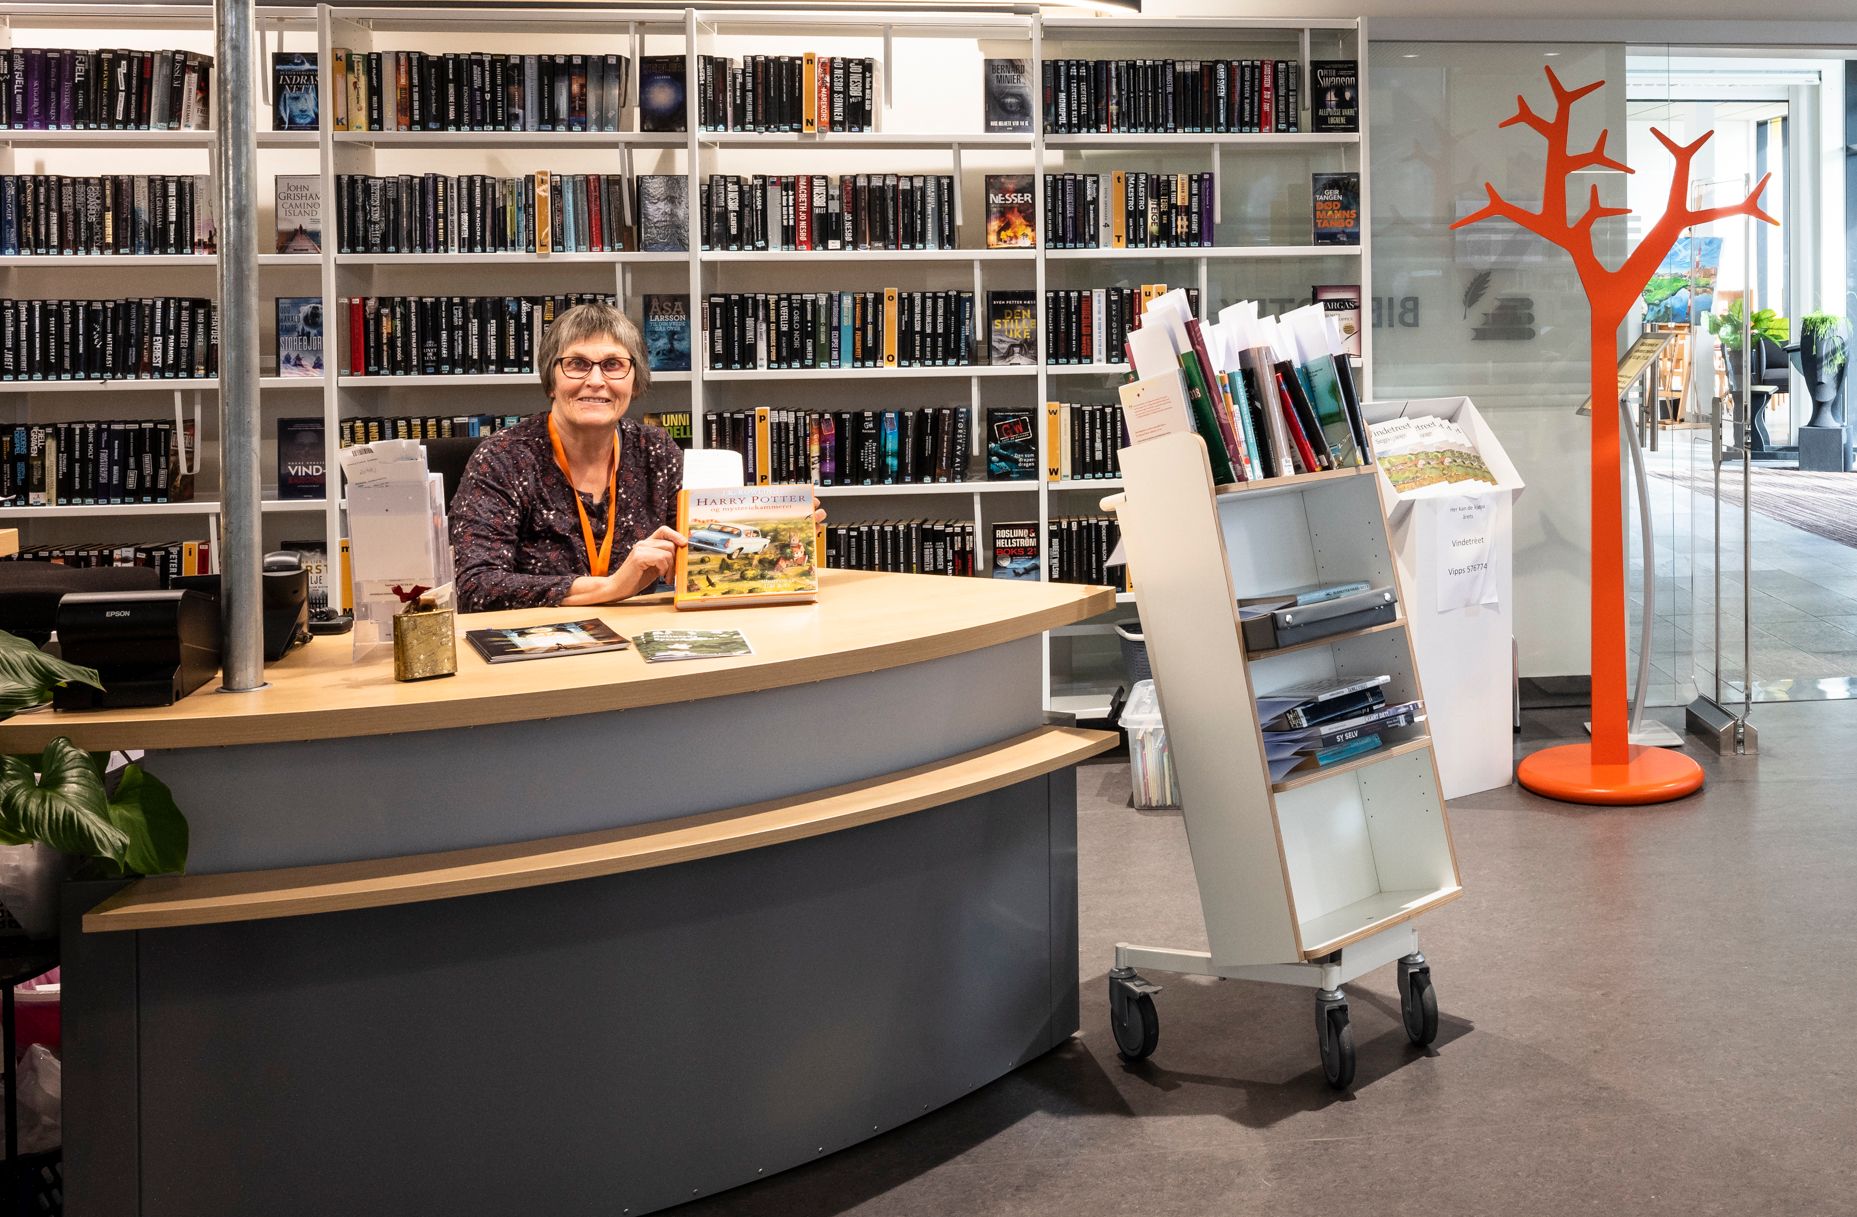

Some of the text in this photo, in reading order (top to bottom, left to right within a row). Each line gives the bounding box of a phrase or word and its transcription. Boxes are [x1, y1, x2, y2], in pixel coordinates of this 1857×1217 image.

[336, 53, 343, 61] k
[75, 56, 85, 83] FJELL
[991, 64, 1025, 74] BERNARD
[14, 71, 24, 95] FJELL
[833, 69, 844, 91] NESBØ
[849, 63, 863, 96] JO NESBØ
[996, 75, 1021, 84] MINIER
[1217, 80, 1225, 96] SVEEN
[820, 88, 828, 121] MAREKORS
[833, 93, 844, 121] SØNNEN
[1058, 92, 1066, 125] MONOPOL
[806, 118, 814, 126] N
[286, 182, 310, 192] JOHN
[813, 178, 827, 207] JO NESBØ
[727, 183, 739, 211] JO NESBØ
[989, 193, 1032, 204] NESSER
[155, 197, 163, 228] GRISHAM
[168, 197, 176, 221] GRISHAM
[799, 182, 807, 241] MACBETH JO NESBØ
[1315, 201, 1341, 211] DØD
[371, 206, 380, 222] KING
[1315, 209, 1357, 219] MANNS
[845, 212, 853, 241] JO NESBØ
[1316, 218, 1355, 228] TANGO
[1115, 235, 1123, 243] T
[650, 298, 684, 314] ÅSA
[1323, 301, 1355, 309] ARGAS
[197, 313, 204, 322] MO
[650, 314, 686, 322] LARSSON
[780, 301, 788, 331] ULVEFELLEN
[1005, 309, 1031, 319] DEN
[180, 310, 189, 348] MO HAYDER
[211, 316, 219, 344] HAYDER
[994, 319, 1036, 329] STILLE
[152, 336, 162, 367] EVEREST
[4, 350, 13, 370] JAGET
[662, 413, 690, 427] UNNI
[667, 426, 692, 438] DELL
[1373, 422, 1412, 437] indetreet
[956, 445, 961, 455] AV
[696, 494, 807, 507] HARRY POTTER
[996, 529, 1036, 538] ROSLUND &
[996, 538, 1037, 548] HELLSTRÖM
[1451, 537, 1485, 547] Vindetreet
[996, 548, 1025, 556] BOKS
[305, 565, 327, 574] RST
[1448, 567, 1466, 576] Vipps
[105, 610, 131, 618] EPSON
[1336, 730, 1359, 743] SY SELV
